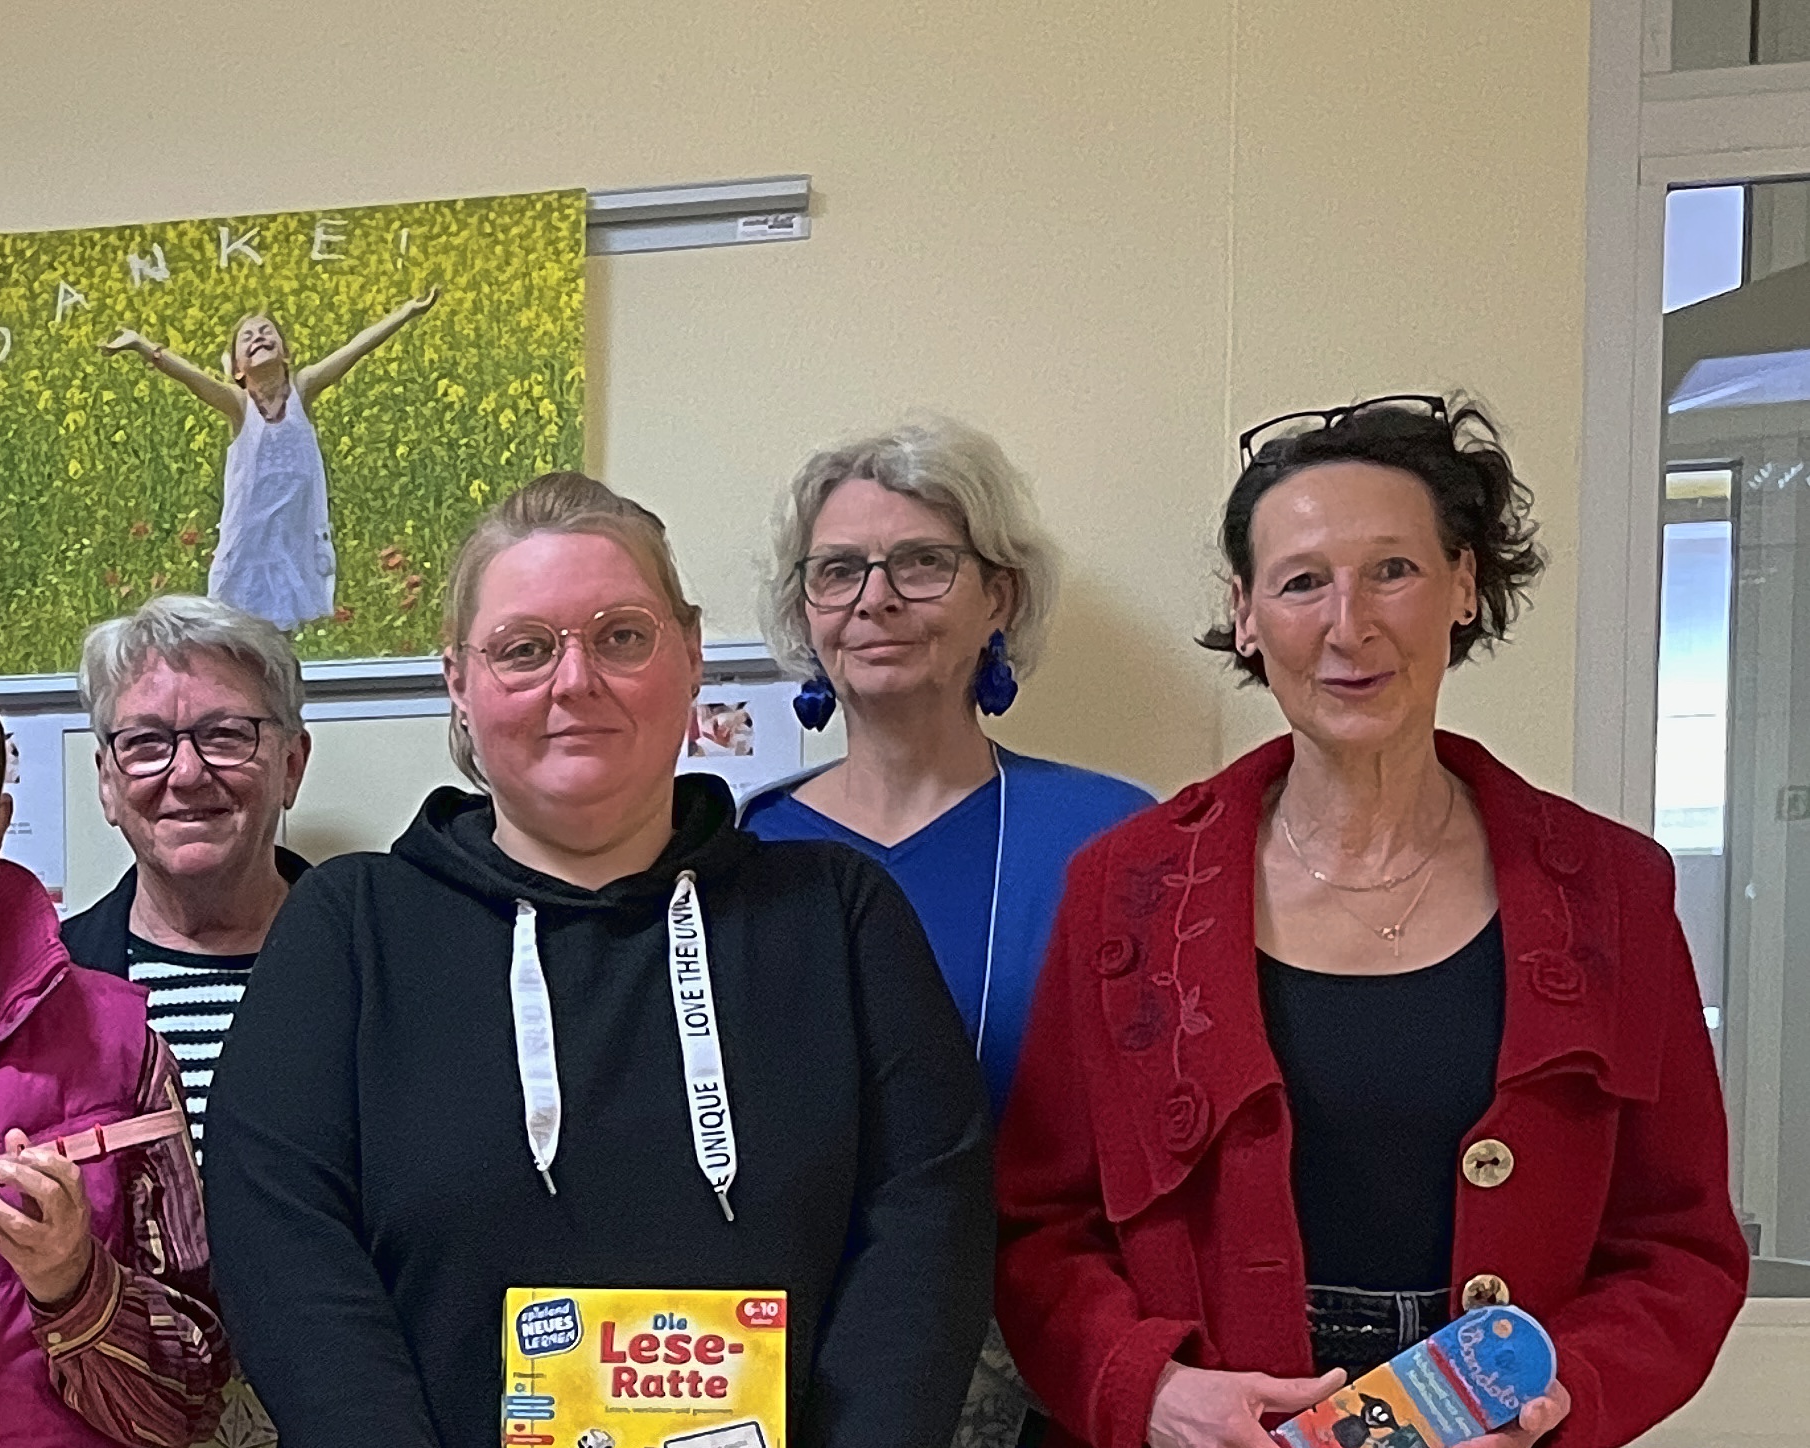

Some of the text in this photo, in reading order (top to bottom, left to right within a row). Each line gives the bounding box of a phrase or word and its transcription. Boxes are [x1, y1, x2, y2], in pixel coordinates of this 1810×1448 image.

[675, 945, 702, 985] THE
[680, 988, 711, 1038] LOVE
[693, 1081, 731, 1170] UNIQUE
[521, 1315, 574, 1337] NEUES
[652, 1312, 688, 1331] Die
[743, 1301, 779, 1317] 6-10
[600, 1320, 745, 1364] Lese-
[611, 1366, 729, 1399] Ratte
